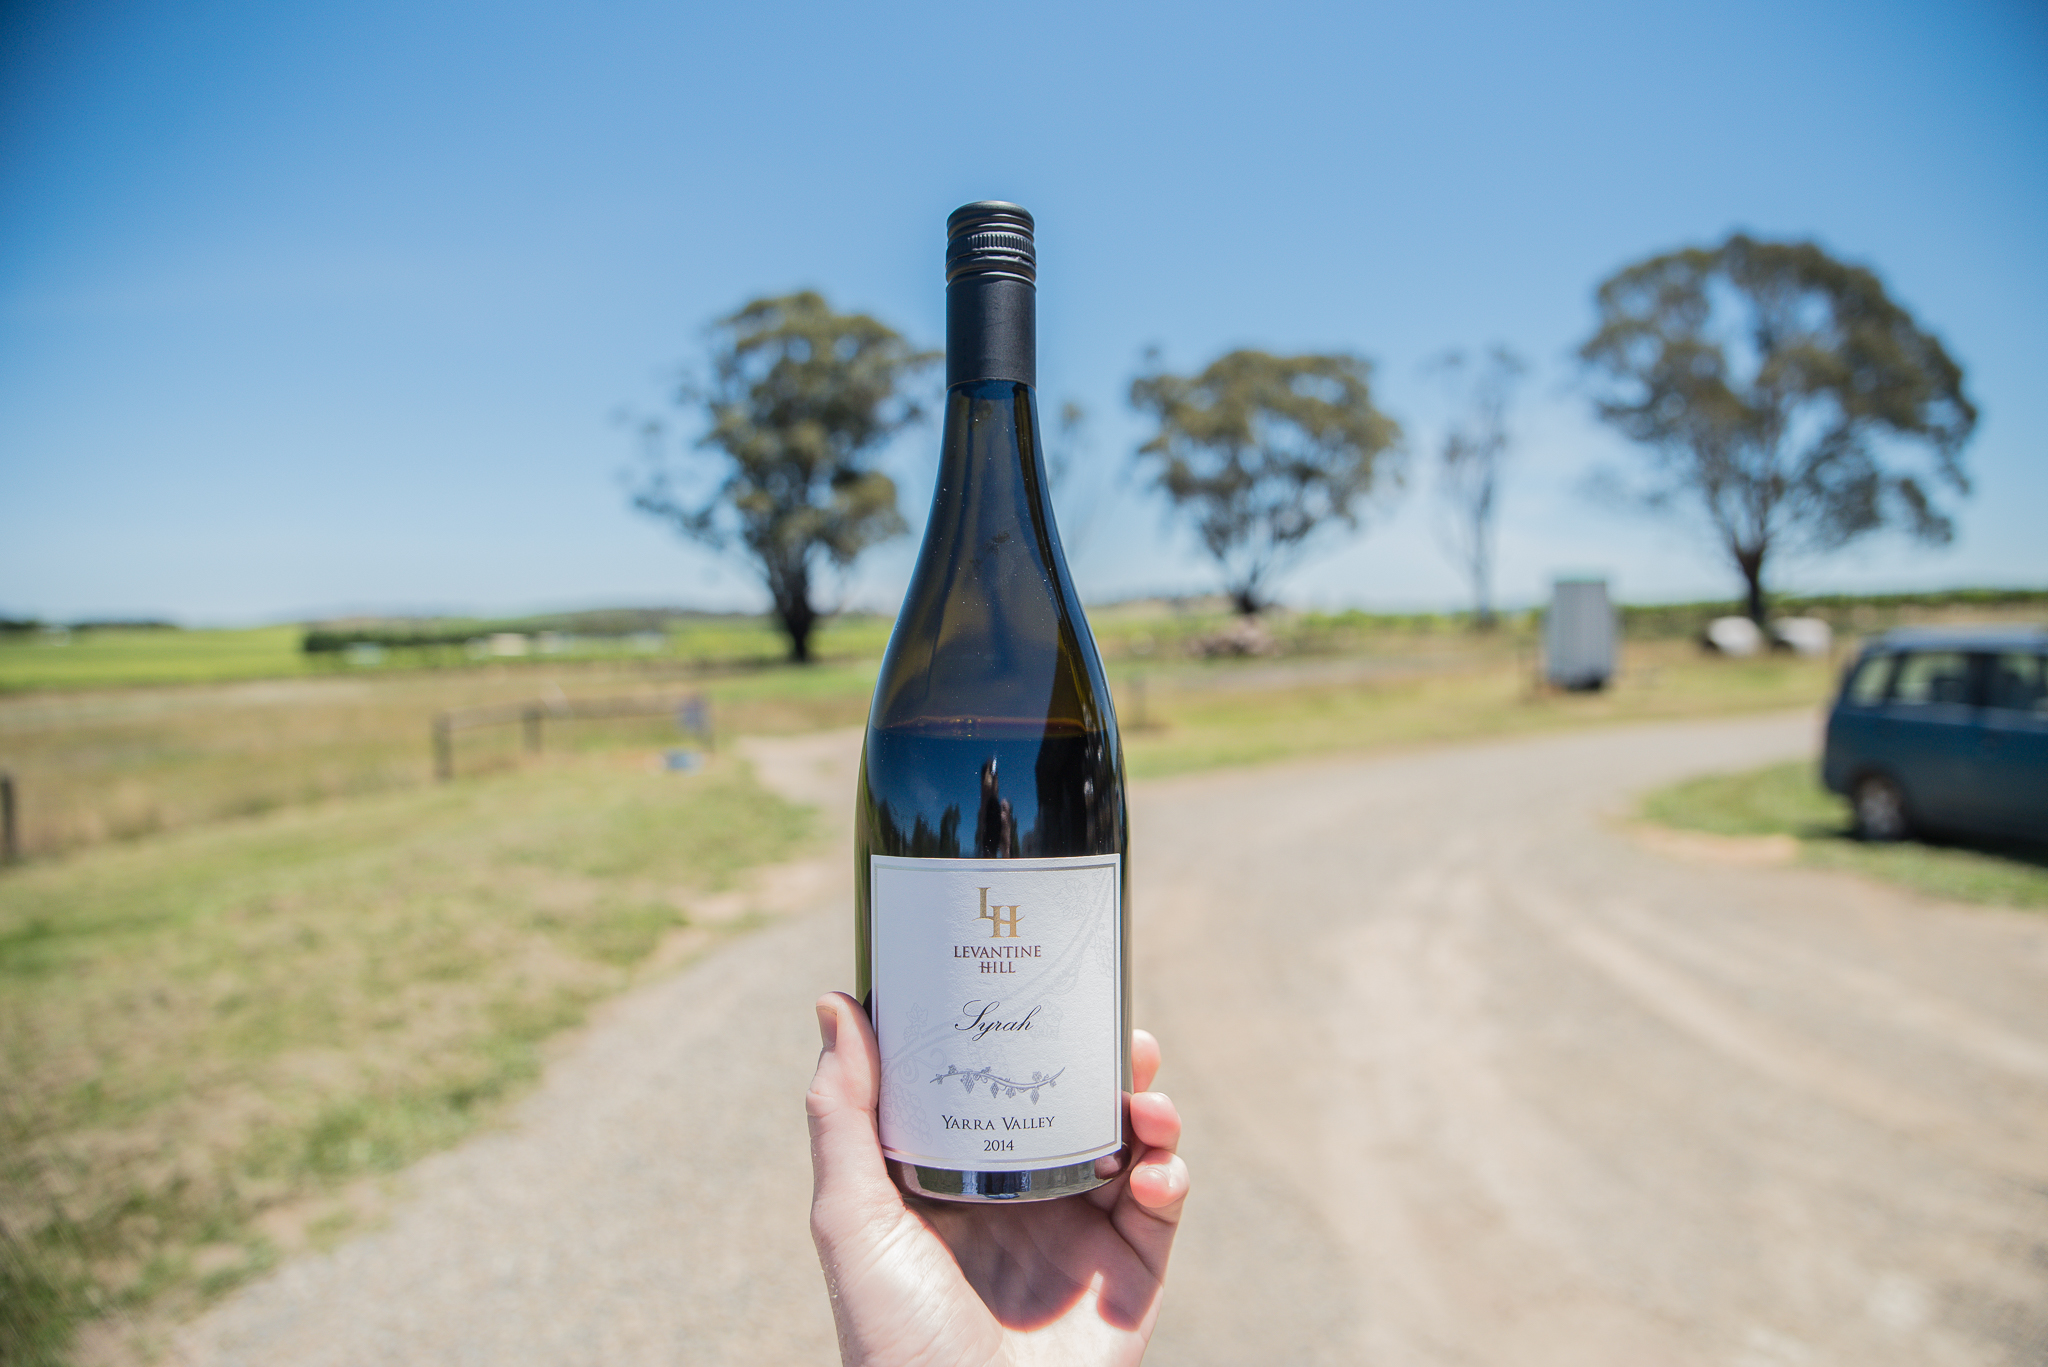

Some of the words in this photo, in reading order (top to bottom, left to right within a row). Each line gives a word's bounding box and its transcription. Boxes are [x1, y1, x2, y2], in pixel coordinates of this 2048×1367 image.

[953, 945, 1041, 959] LEVANTINE
[978, 961, 1016, 974] HILL
[954, 999, 1042, 1042] Syrah
[941, 1115, 996, 1131] YARRA
[1001, 1115, 1055, 1131] VALLEY
[983, 1139, 1014, 1152] 2014
